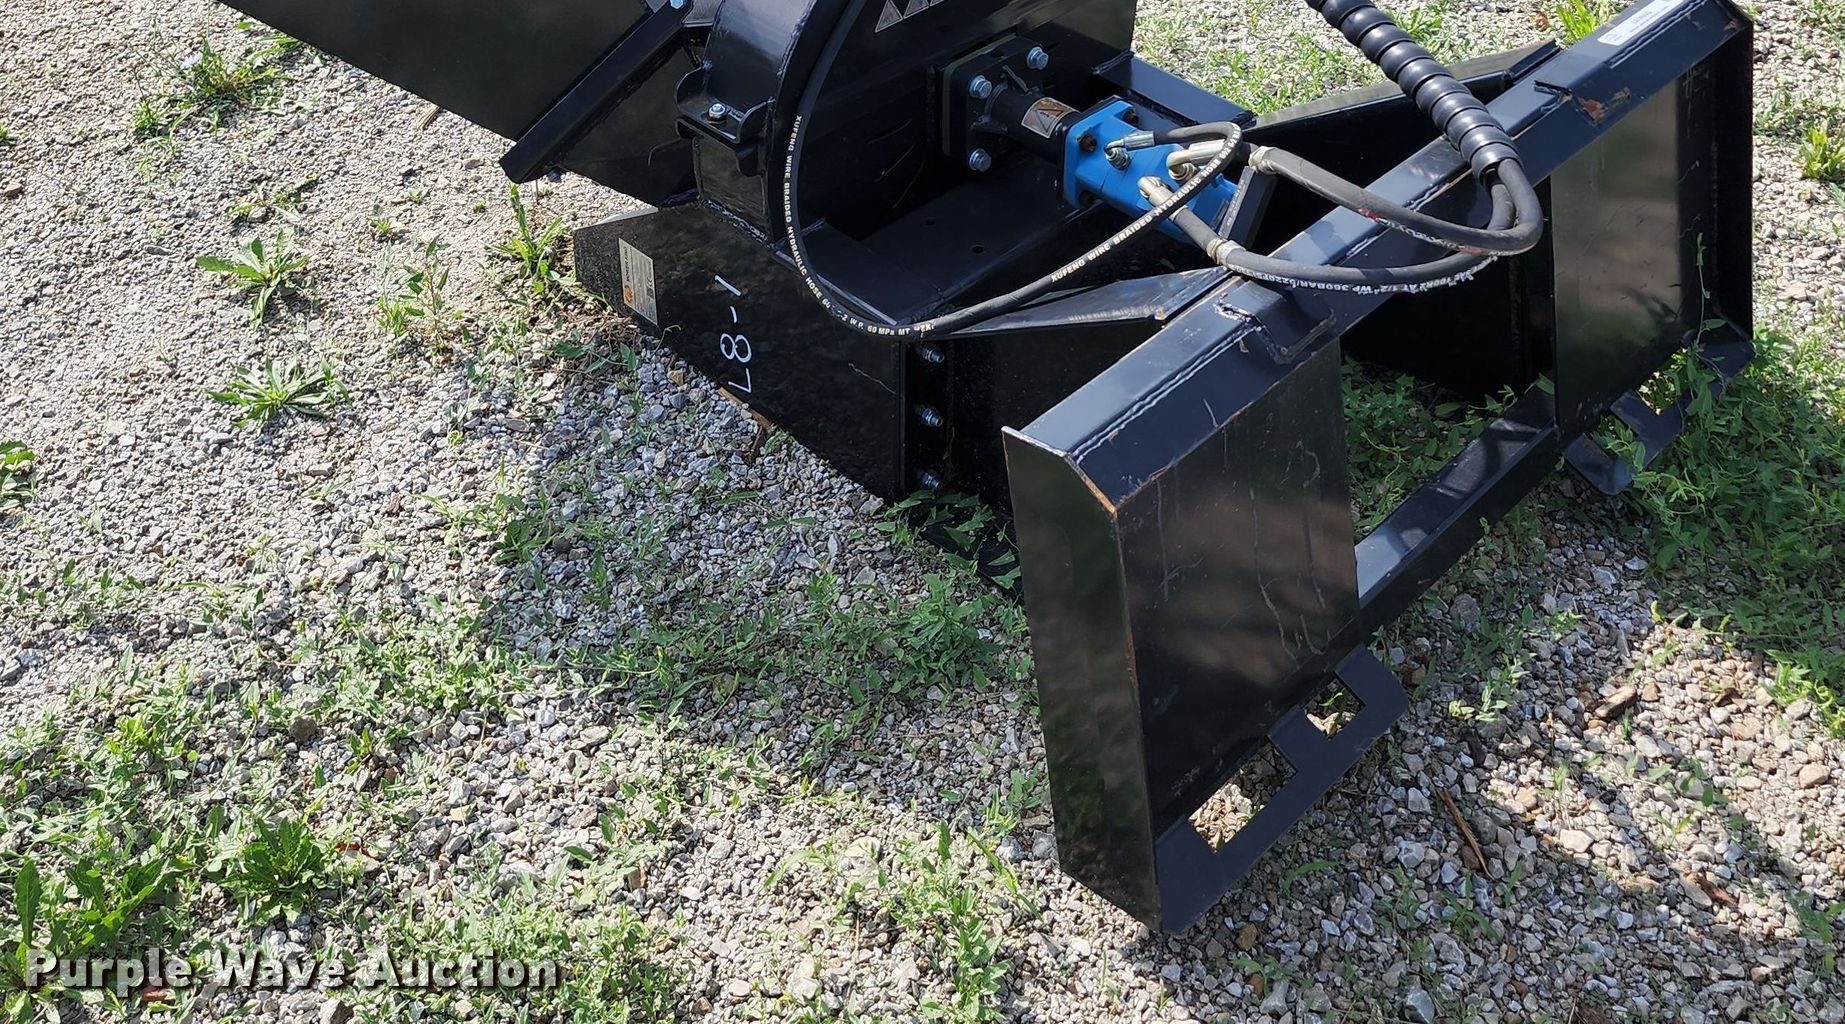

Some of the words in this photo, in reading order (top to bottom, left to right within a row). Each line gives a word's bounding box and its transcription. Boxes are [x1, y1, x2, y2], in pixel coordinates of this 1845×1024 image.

[788, 115, 803, 152] XUFENG
[784, 155, 793, 179] WIRE
[784, 182, 792, 224] BRAIDED
[1050, 258, 1086, 283] XUFENG
[1087, 243, 1112, 262] WIRE
[1112, 214, 1154, 246] BRAIDED
[1154, 176, 1202, 216] HYDRAULIC
[1200, 159, 1222, 178] HOSE
[786, 226, 808, 276] HYDRAULIC
[805, 276, 822, 300] HOSE
[850, 317, 864, 330] W.P.
[866, 324, 877, 334] 60
[898, 327, 910, 336] MT
